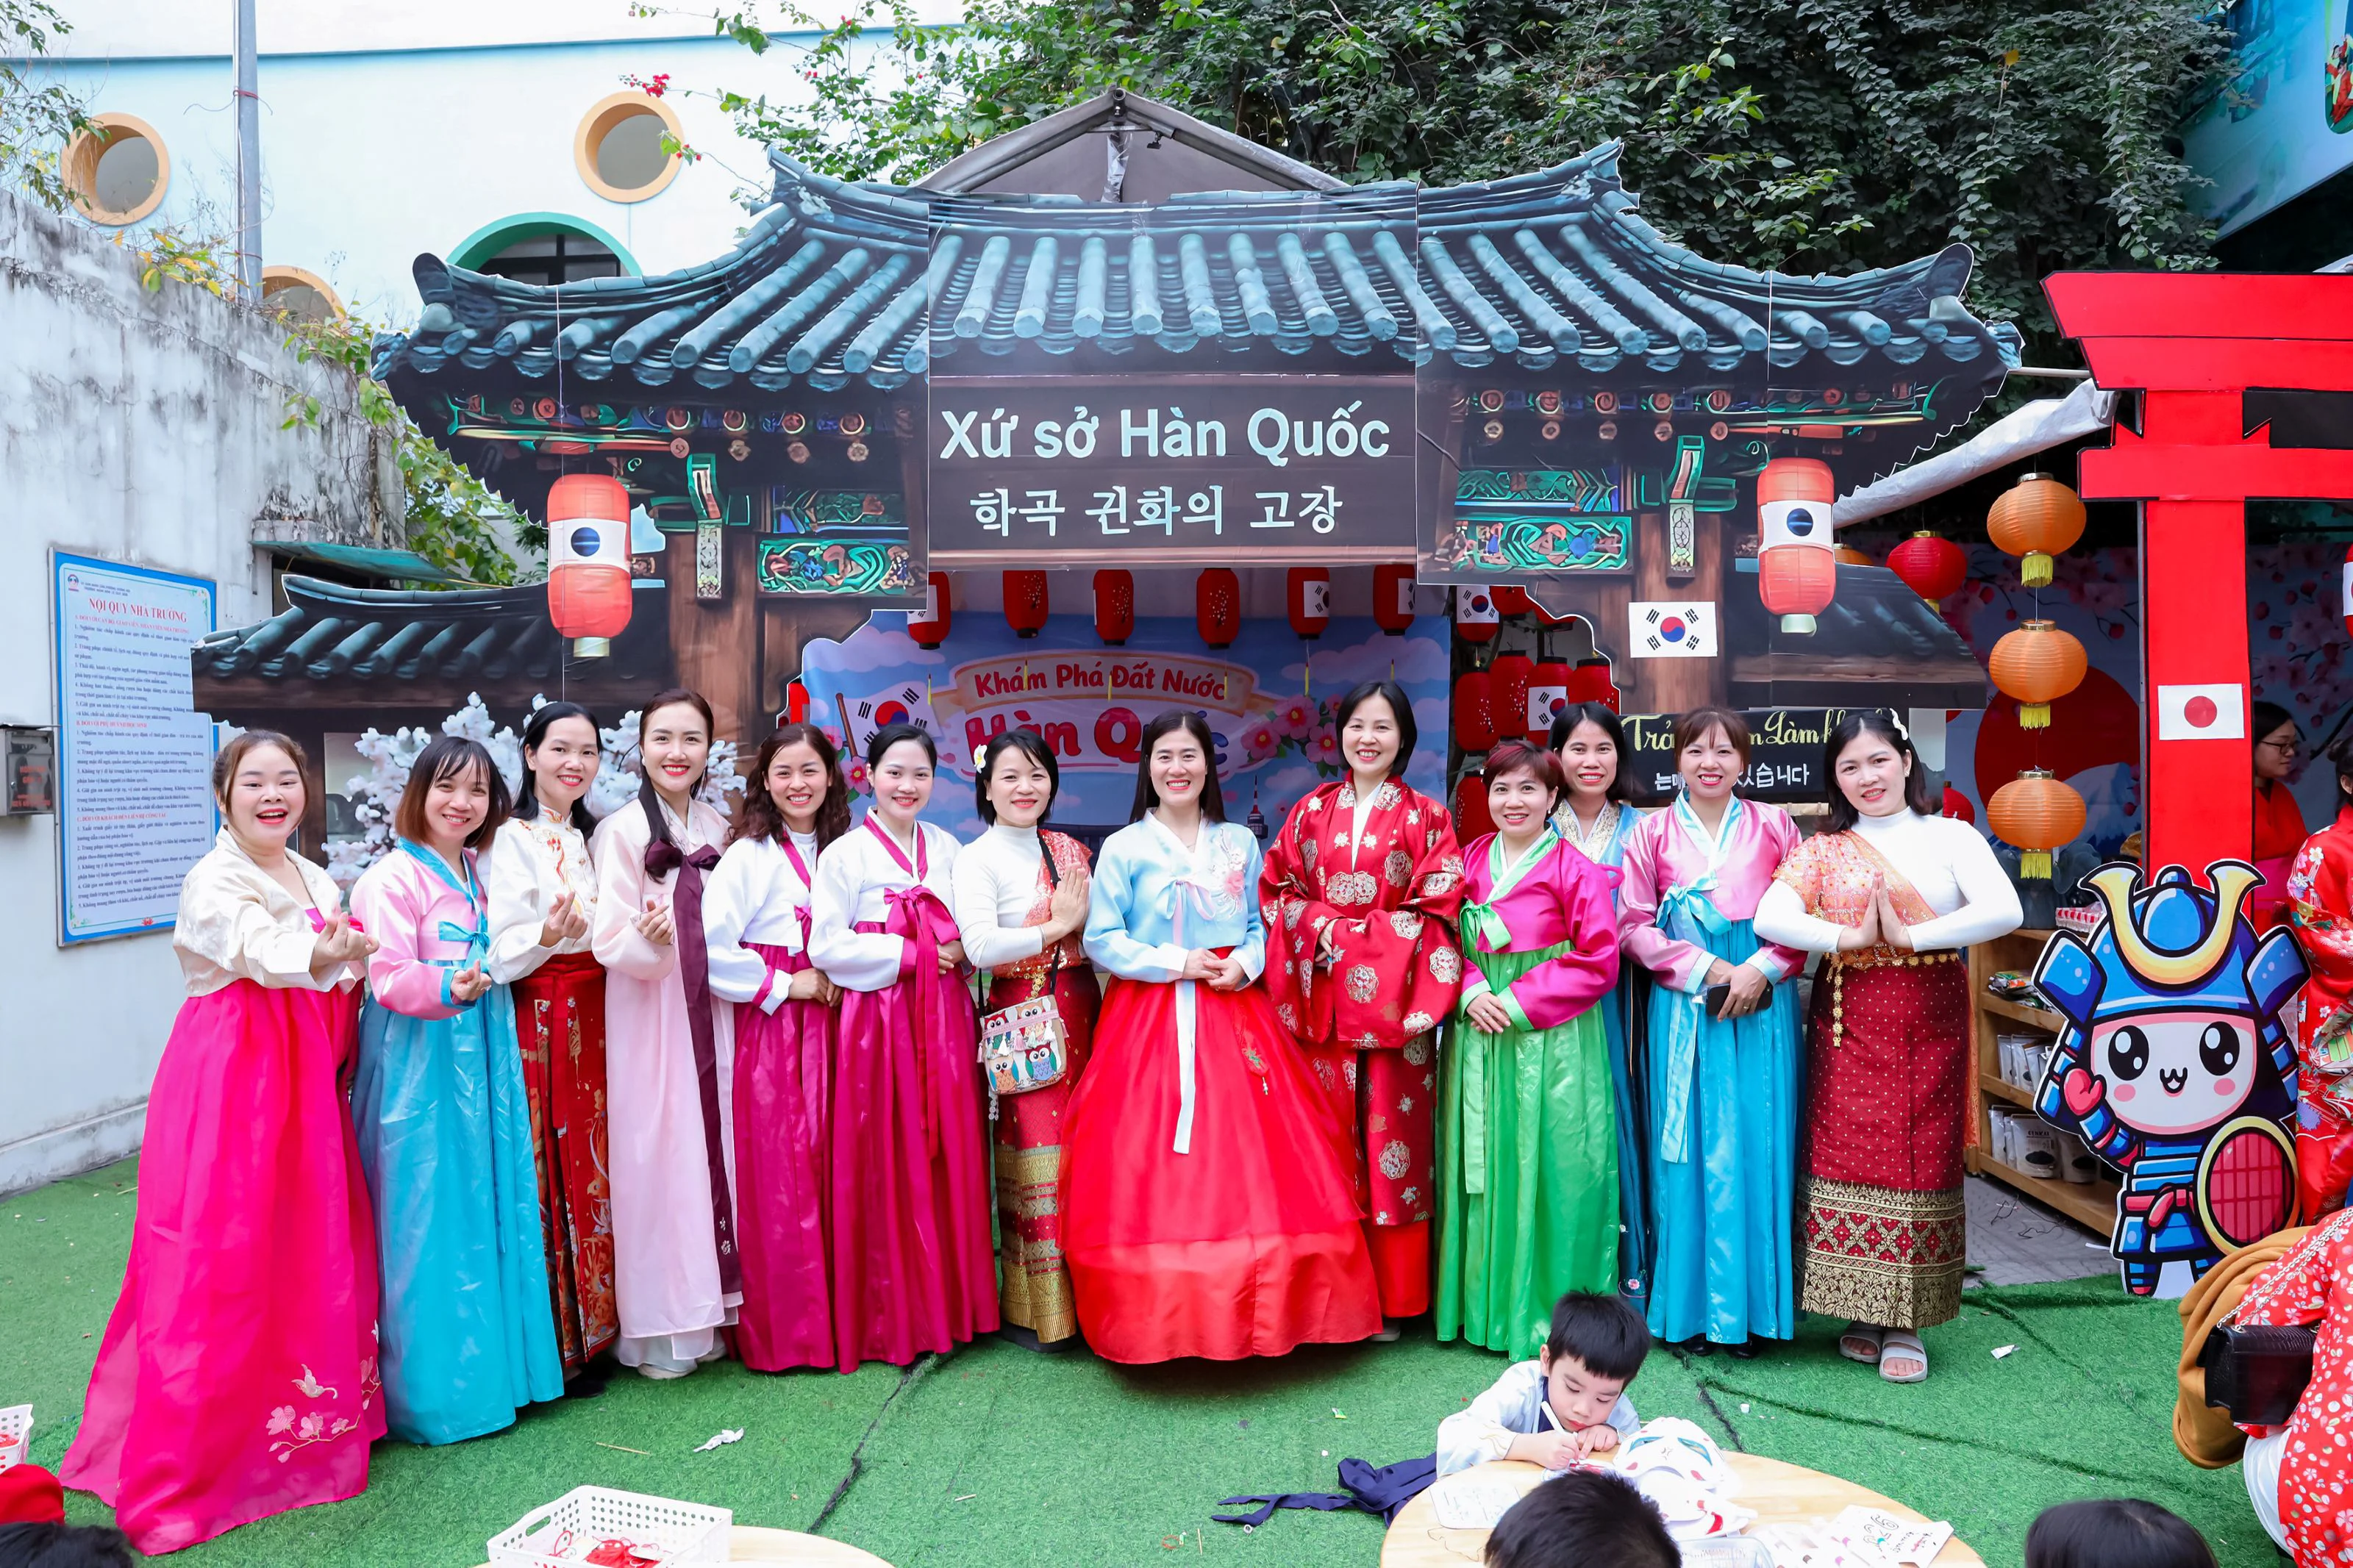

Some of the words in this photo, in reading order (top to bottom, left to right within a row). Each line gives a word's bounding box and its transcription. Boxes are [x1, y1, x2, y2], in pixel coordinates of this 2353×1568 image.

[940, 408, 1019, 459] Xứ
[1034, 406, 1099, 459] sở
[1120, 407, 1227, 458] Hàn
[1247, 400, 1390, 467] Quốc
[109, 603, 128, 616] QUY
[974, 667, 1046, 698] Khám
[1056, 662, 1103, 688] Phá
[1110, 662, 1155, 689] Đất
[1162, 669, 1226, 701] Nước
